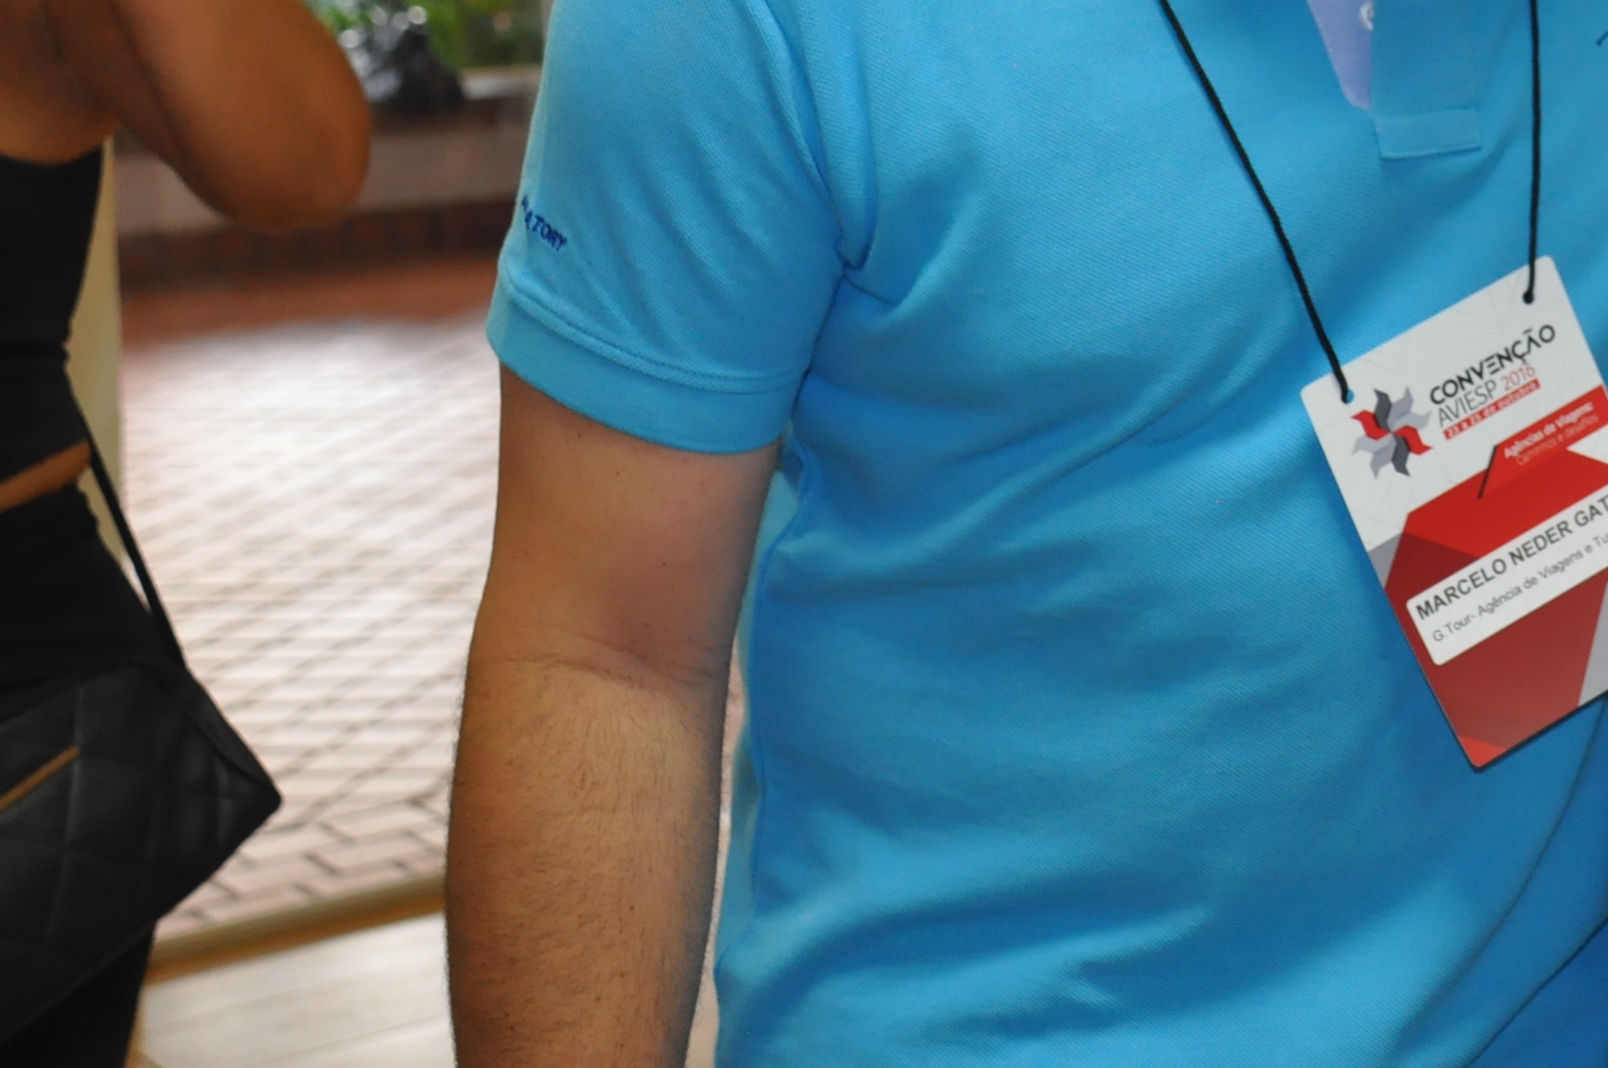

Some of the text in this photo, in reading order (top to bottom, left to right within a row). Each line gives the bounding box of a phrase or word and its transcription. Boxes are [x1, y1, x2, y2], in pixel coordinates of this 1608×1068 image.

[1430, 324, 1555, 405] CONVENÇÃO
[1438, 365, 1536, 427] AVIESP 2016
[1415, 558, 1507, 620] MARCELO
[1508, 520, 1573, 566] NEDER
[1478, 583, 1523, 617] Agência
[1523, 573, 1539, 590] de
[1538, 550, 1585, 579] Viagens
[1585, 544, 1593, 555] e
